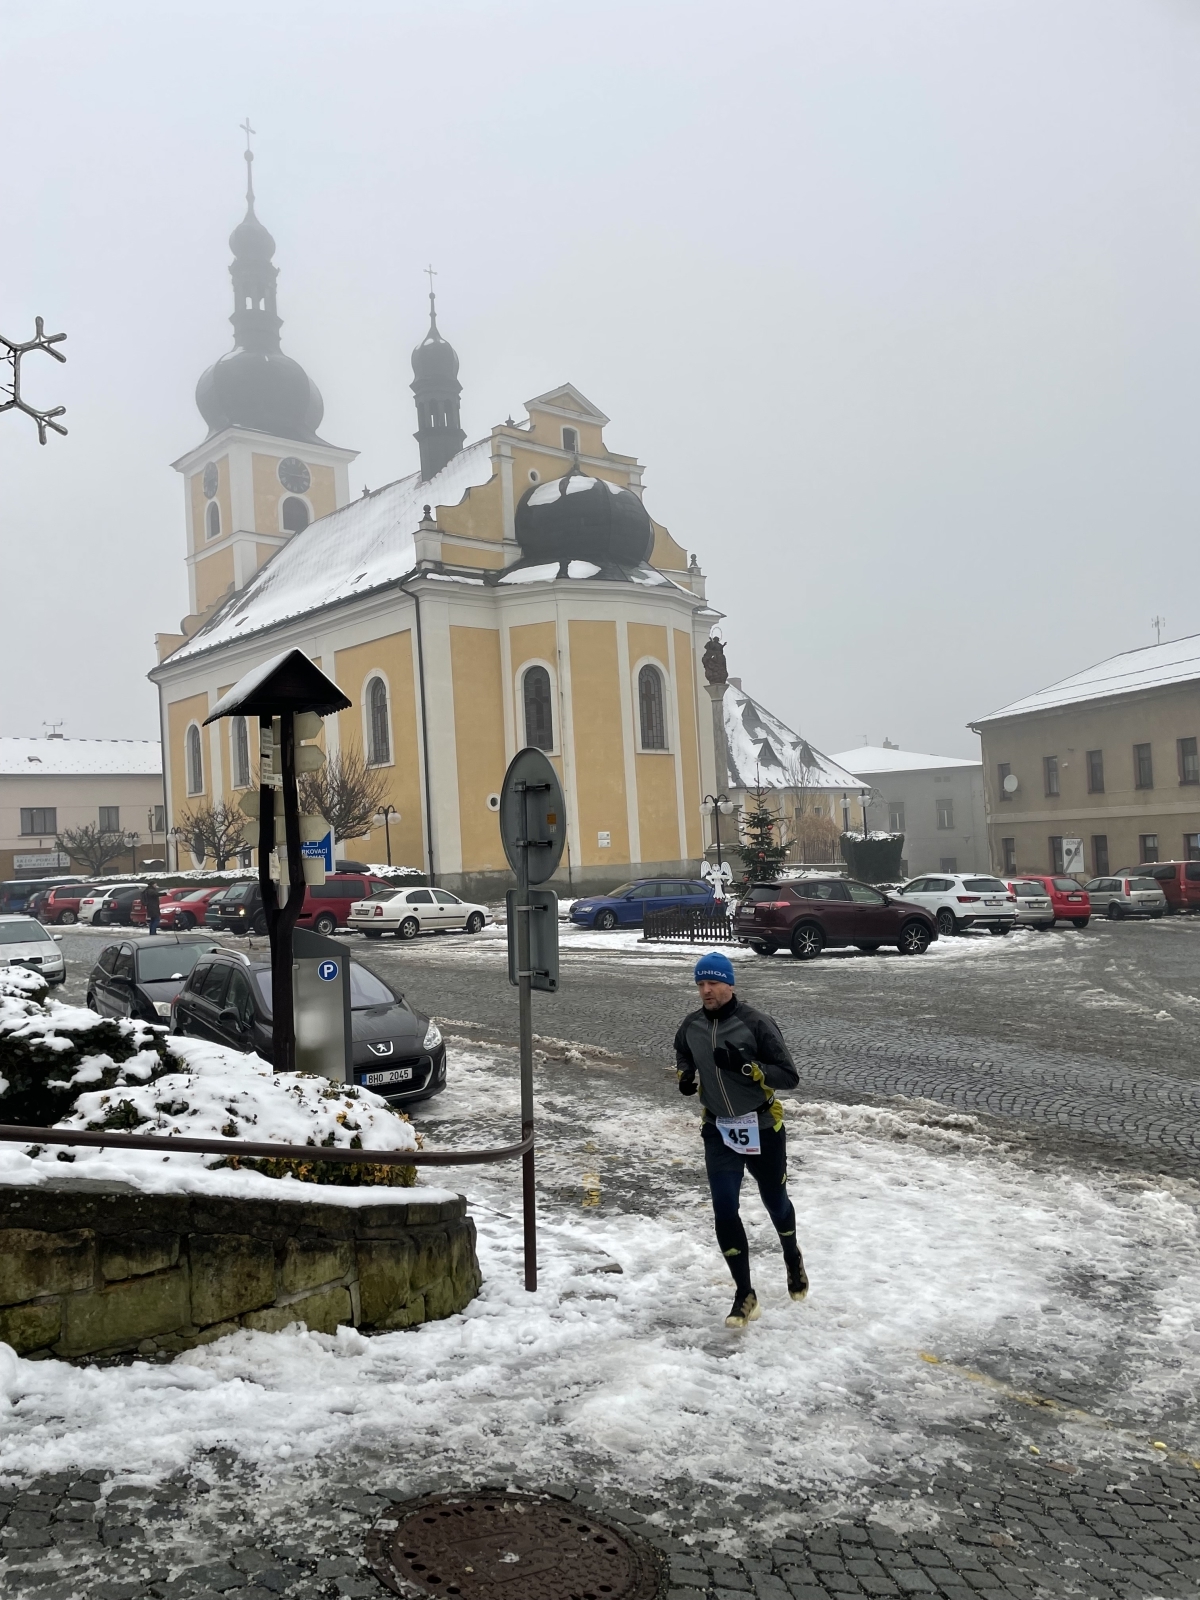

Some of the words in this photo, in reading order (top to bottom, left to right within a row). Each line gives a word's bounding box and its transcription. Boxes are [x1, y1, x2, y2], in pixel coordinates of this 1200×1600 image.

[301, 847, 328, 855] RKOVACÍ
[323, 964, 334, 978] P
[697, 970, 727, 978] UNIQA
[389, 1070, 408, 1081] 2045
[728, 1129, 749, 1145] 45
